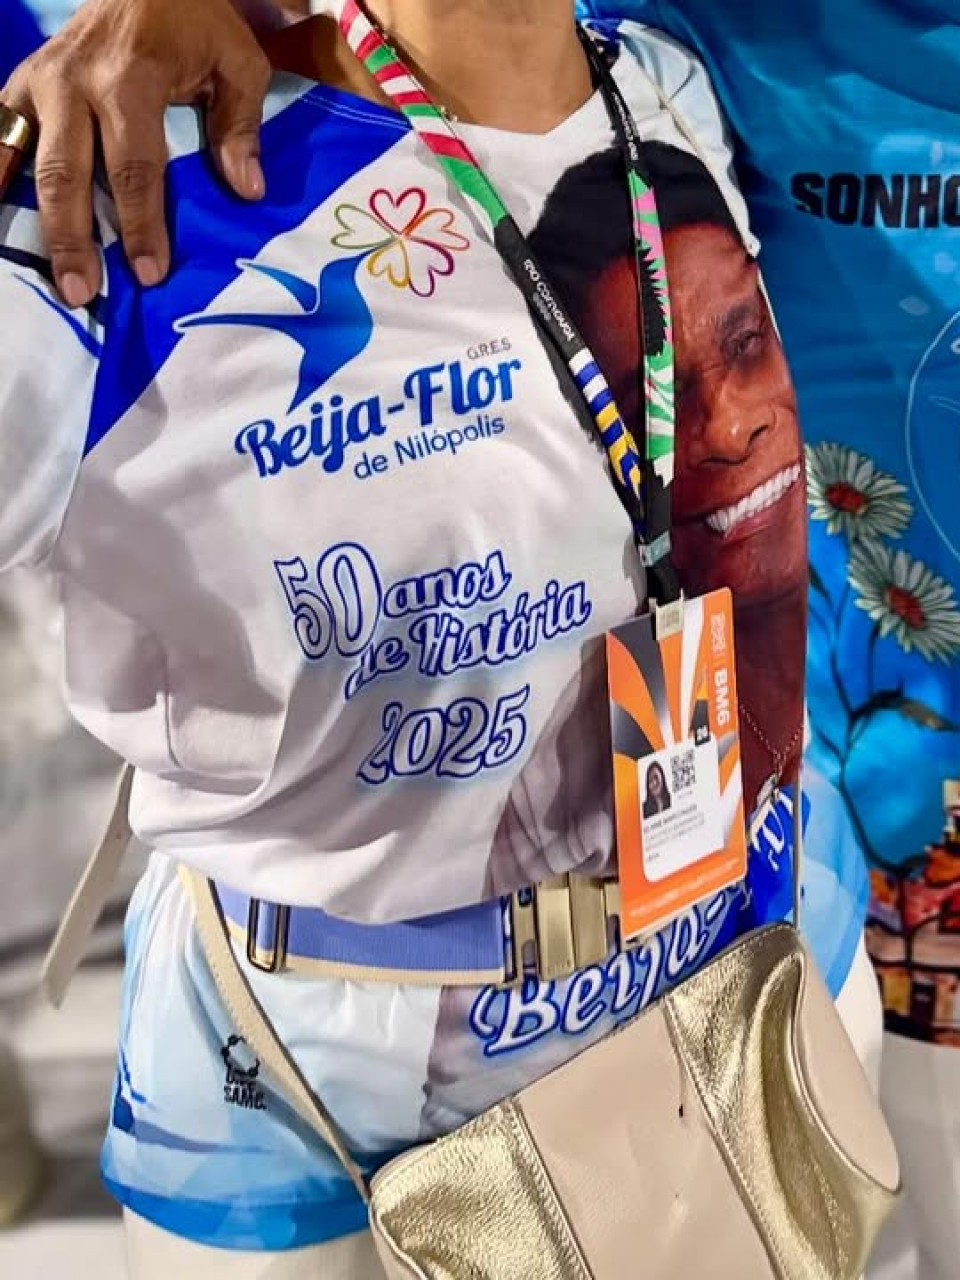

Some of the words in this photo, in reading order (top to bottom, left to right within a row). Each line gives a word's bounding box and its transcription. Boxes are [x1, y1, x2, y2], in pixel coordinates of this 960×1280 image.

[234, 359, 522, 478] Beija-Flor
[354, 453, 389, 480] de
[398, 416, 505, 466] Nilópolis
[273, 541, 381, 659] 50
[383, 550, 511, 617] anos
[409, 579, 592, 676] História
[356, 683, 530, 785] 2025
